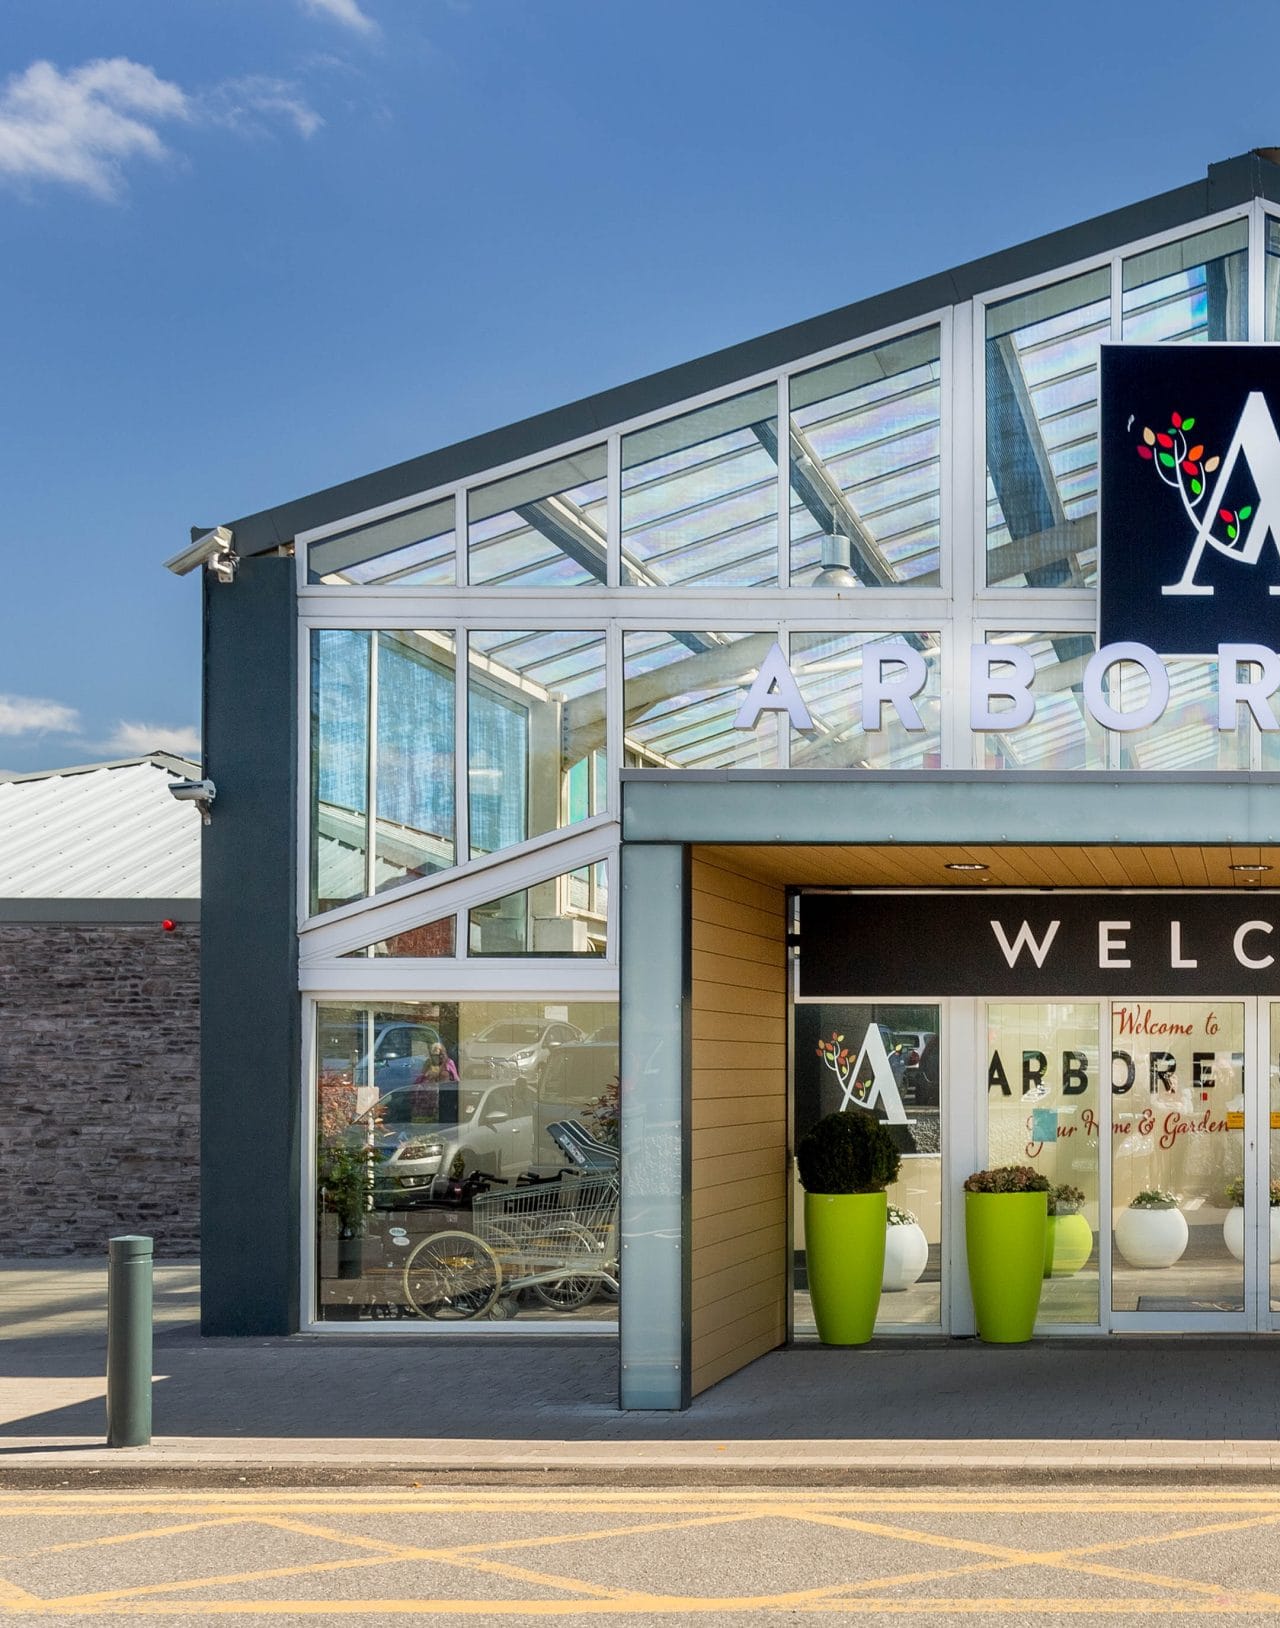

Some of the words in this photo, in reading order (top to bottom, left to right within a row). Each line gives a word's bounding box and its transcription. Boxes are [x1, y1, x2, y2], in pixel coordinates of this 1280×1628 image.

[1112, 1004, 1194, 1035] Welcome
[1205, 1011, 1220, 1035] to
[839, 1022, 918, 1125] A
[1081, 1109, 1131, 1137] Hme
[1138, 1109, 1155, 1136] &
[1160, 1108, 1229, 1149] Garden
